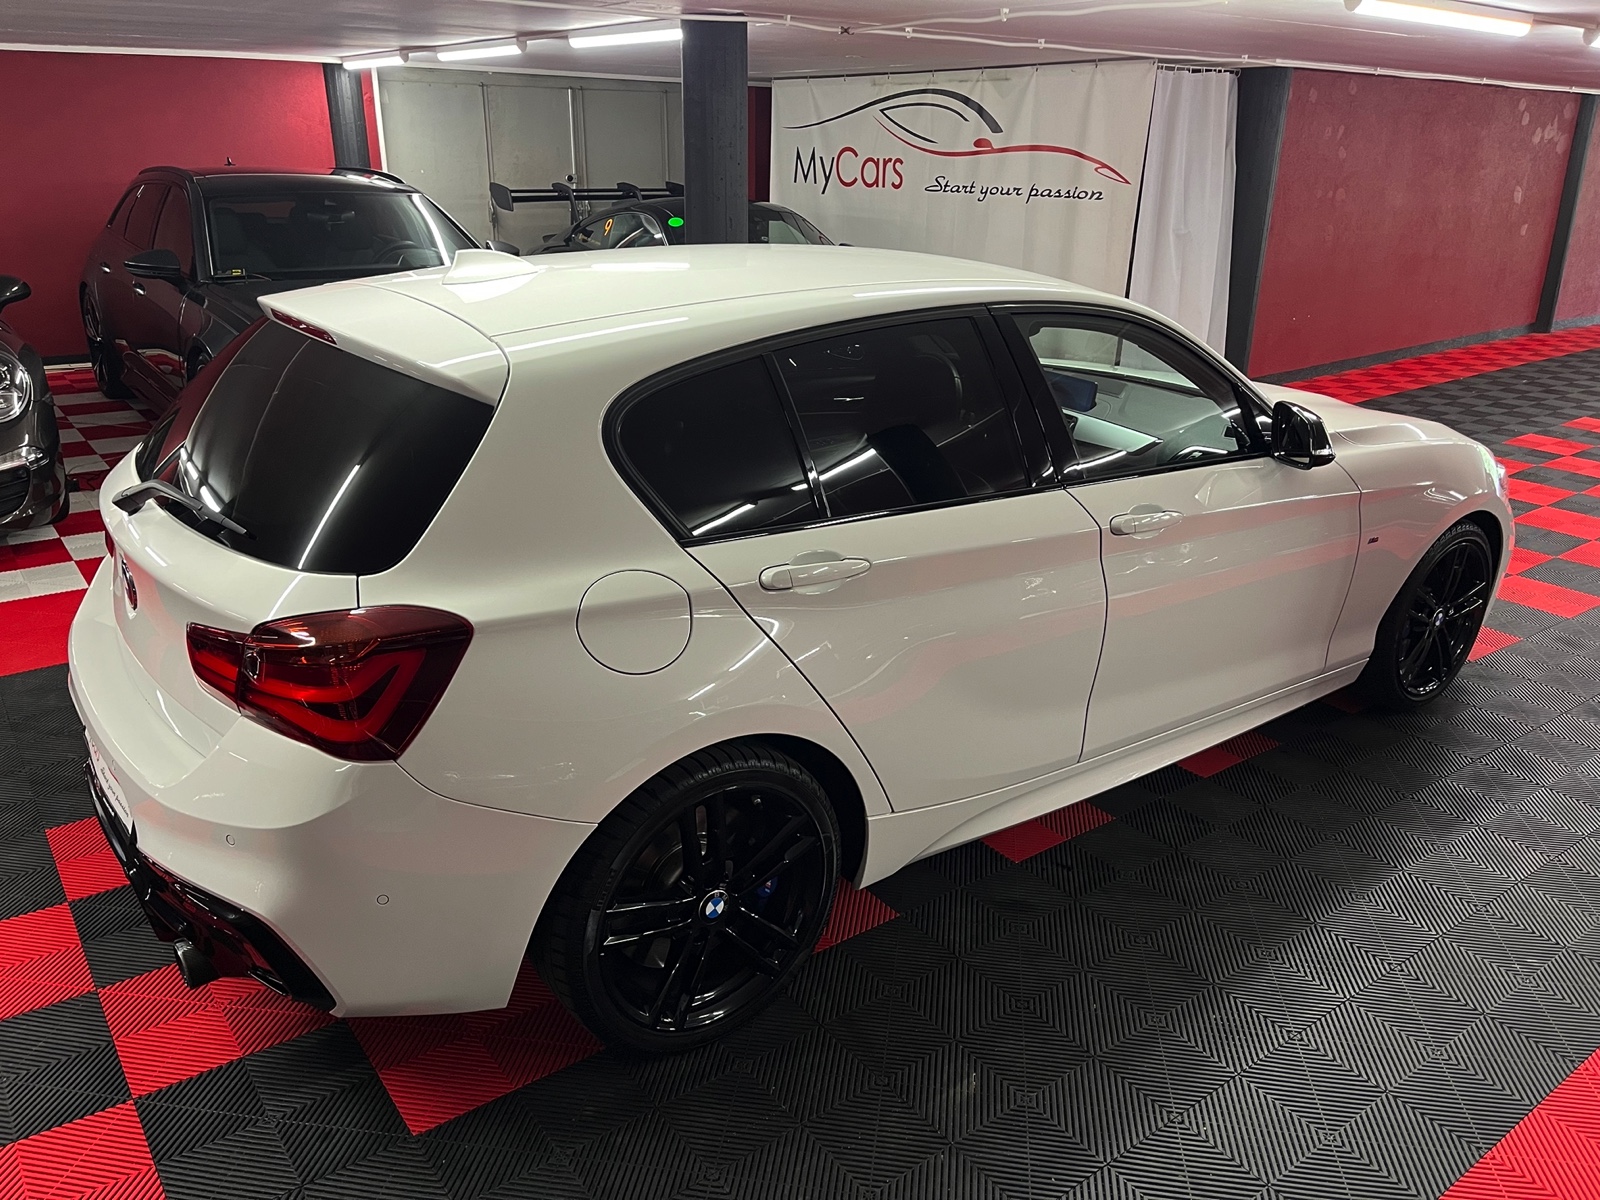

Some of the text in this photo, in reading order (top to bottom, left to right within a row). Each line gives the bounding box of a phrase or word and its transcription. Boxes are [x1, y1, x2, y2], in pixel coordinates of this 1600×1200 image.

[793, 146, 904, 195] MyCars
[924, 175, 1104, 204] Start your passion
[604, 218, 613, 236] 9
